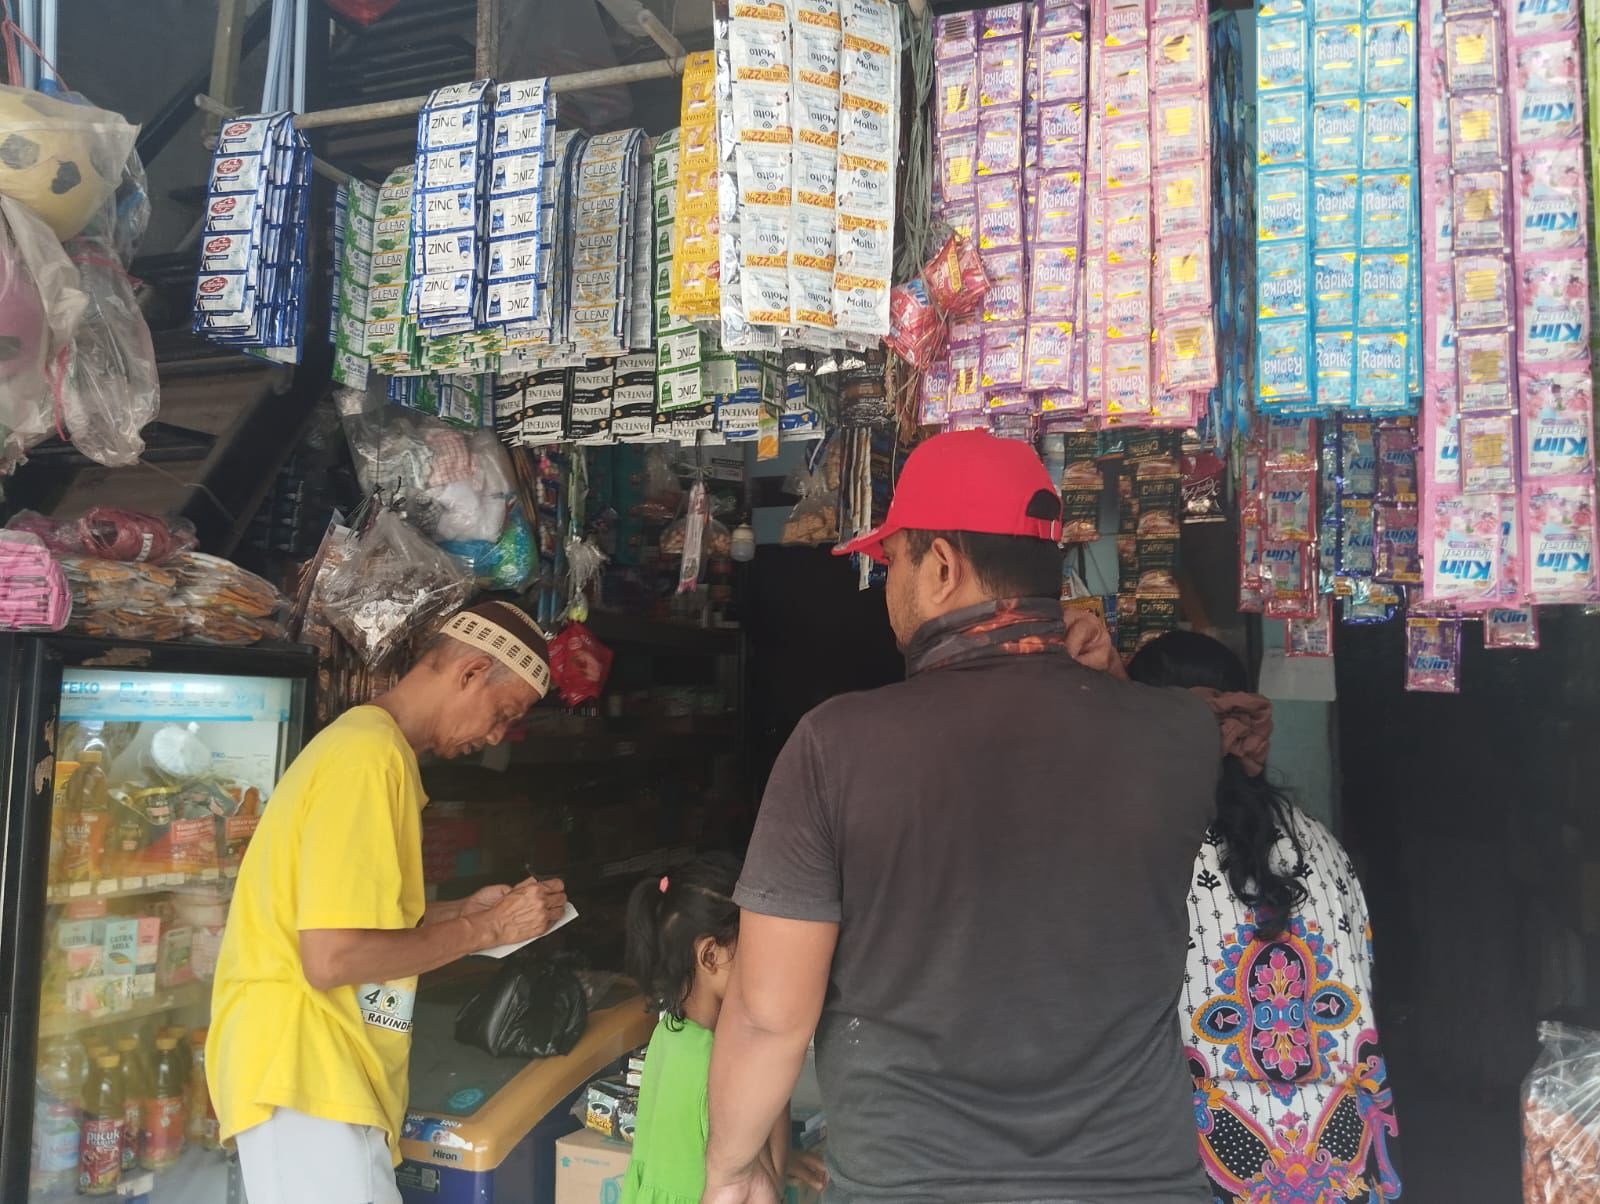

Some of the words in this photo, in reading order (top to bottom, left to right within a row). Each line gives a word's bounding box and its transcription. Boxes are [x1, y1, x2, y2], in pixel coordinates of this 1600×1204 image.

[854, 3, 879, 16] Molto
[750, 47, 776, 59] Molto
[811, 52, 836, 65] Molto
[856, 58, 880, 72] Molto
[517, 86, 541, 100] ZINC
[753, 110, 779, 121] Molto
[811, 112, 837, 125] Molto
[1521, 103, 1575, 122] Klin
[431, 115, 457, 129] ZINC
[853, 117, 878, 131] Molto
[1043, 119, 1077, 135] Rapika
[515, 127, 537, 141] ZINC
[429, 155, 455, 169] ZINC
[584, 162, 618, 174] CLEAR
[512, 168, 535, 183] ZINC
[757, 171, 784, 182] Molto
[810, 172, 834, 185] Molto
[851, 175, 877, 189] Molto
[428, 197, 453, 212] ZINC
[582, 198, 615, 211] CLEAR
[1041, 191, 1075, 209] Rapika
[1263, 202, 1301, 219] Rapika
[378, 220, 406, 231] CLEAR
[511, 211, 533, 227] ZINC
[983, 210, 1016, 229] Rapika
[1525, 212, 1577, 231] Klin
[580, 234, 613, 248] CLEAR
[759, 233, 786, 245] Molto
[806, 235, 833, 248] Molto
[851, 236, 876, 249] Molto
[428, 240, 453, 255] ZINC
[374, 254, 403, 265] CLEAR
[510, 255, 533, 270] ZINC
[577, 271, 610, 284] CLEAR
[1037, 264, 1072, 282] Rapika
[1364, 271, 1403, 289] Rapika
[424, 279, 449, 292] ZINC
[1263, 278, 1302, 296] Rapika
[1316, 271, 1354, 290] Rapika
[371, 288, 399, 299] CLEAR
[762, 291, 788, 302] Molto
[808, 292, 832, 305] Molto
[507, 297, 530, 312] ZINC
[847, 296, 873, 308] Molto
[575, 309, 609, 320] CLEAR
[368, 323, 395, 334] CLEAR
[1529, 324, 1582, 342] Klin
[676, 345, 696, 360] ZINC
[1033, 338, 1067, 355] Rapika
[618, 357, 655, 368] PANTENE
[1264, 357, 1302, 375] Rapika
[1362, 350, 1400, 368] Rapika
[576, 375, 611, 385] PANTENE
[925, 375, 946, 392] Rapi
[528, 387, 562, 399] PANTENE
[616, 388, 653, 400] PANTENE
[678, 384, 698, 399] ZINC
[572, 406, 608, 416] PANTENE
[720, 407, 759, 417] PANTENE
[526, 418, 560, 430] PANTENE
[613, 420, 650, 431] PANTENE
[1533, 437, 1587, 456] Klin
[1537, 552, 1590, 573] Klin
[1439, 560, 1491, 580] Klin
[1493, 610, 1528, 623] Klin
[1415, 656, 1449, 670] Klin
[364, 989, 381, 1005] 4
[87, 1130, 119, 1145] pucuk
[432, 1149, 457, 1161] Hiron
